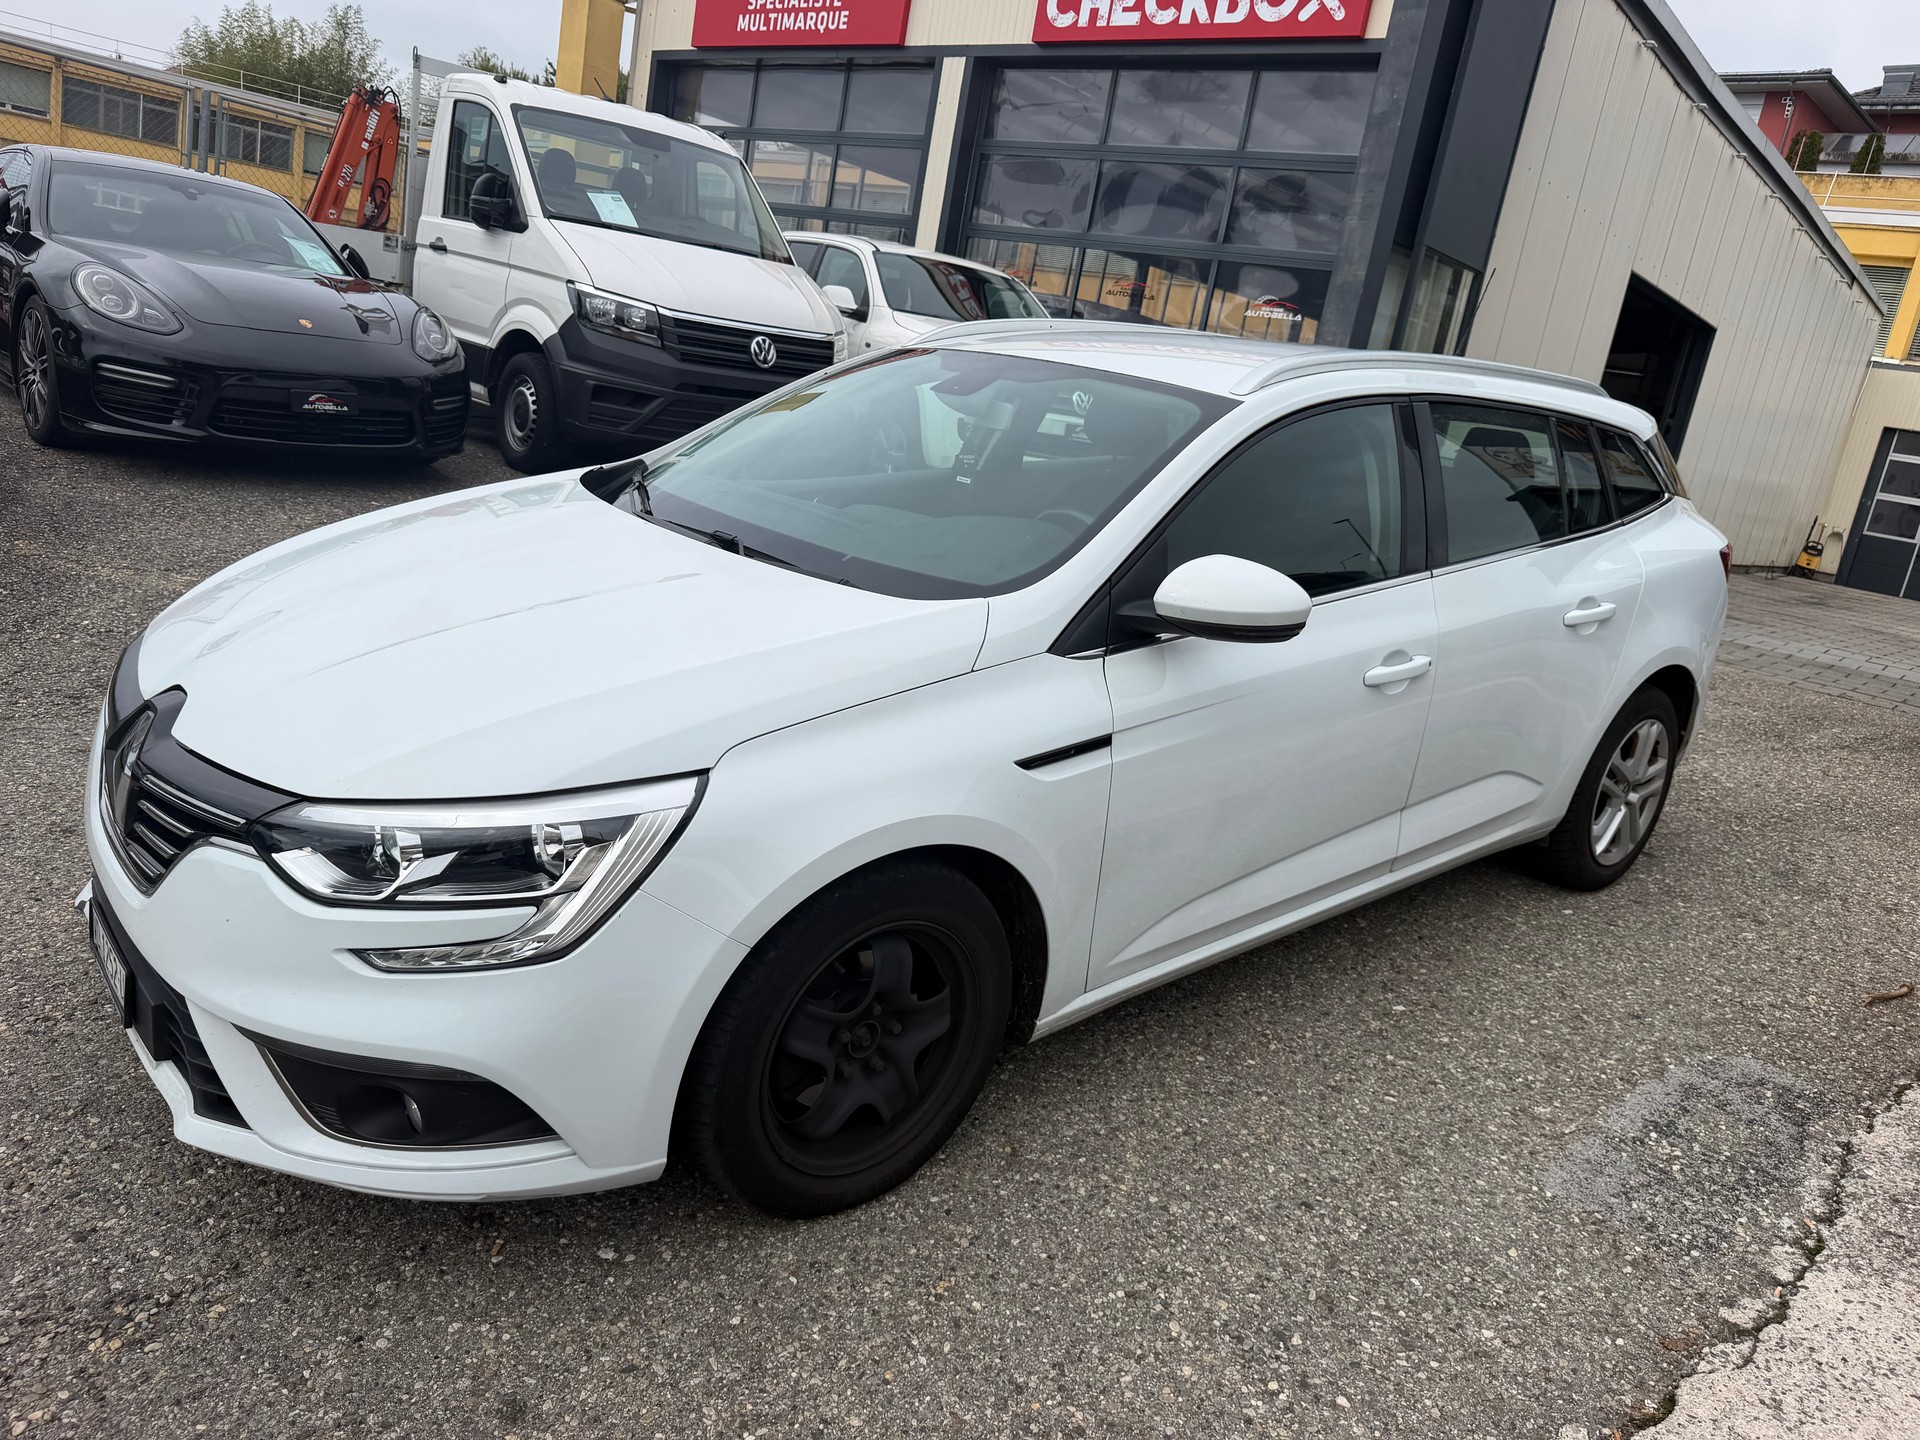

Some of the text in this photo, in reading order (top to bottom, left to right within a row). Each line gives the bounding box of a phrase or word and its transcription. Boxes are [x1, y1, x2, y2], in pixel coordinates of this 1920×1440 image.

[737, 11, 849, 34] MULTIMARQUE
[1105, 289, 1155, 301] AUTOLA
[1244, 309, 1302, 321] AUTOBELLA
[302, 403, 349, 411] AUTOBELLA
